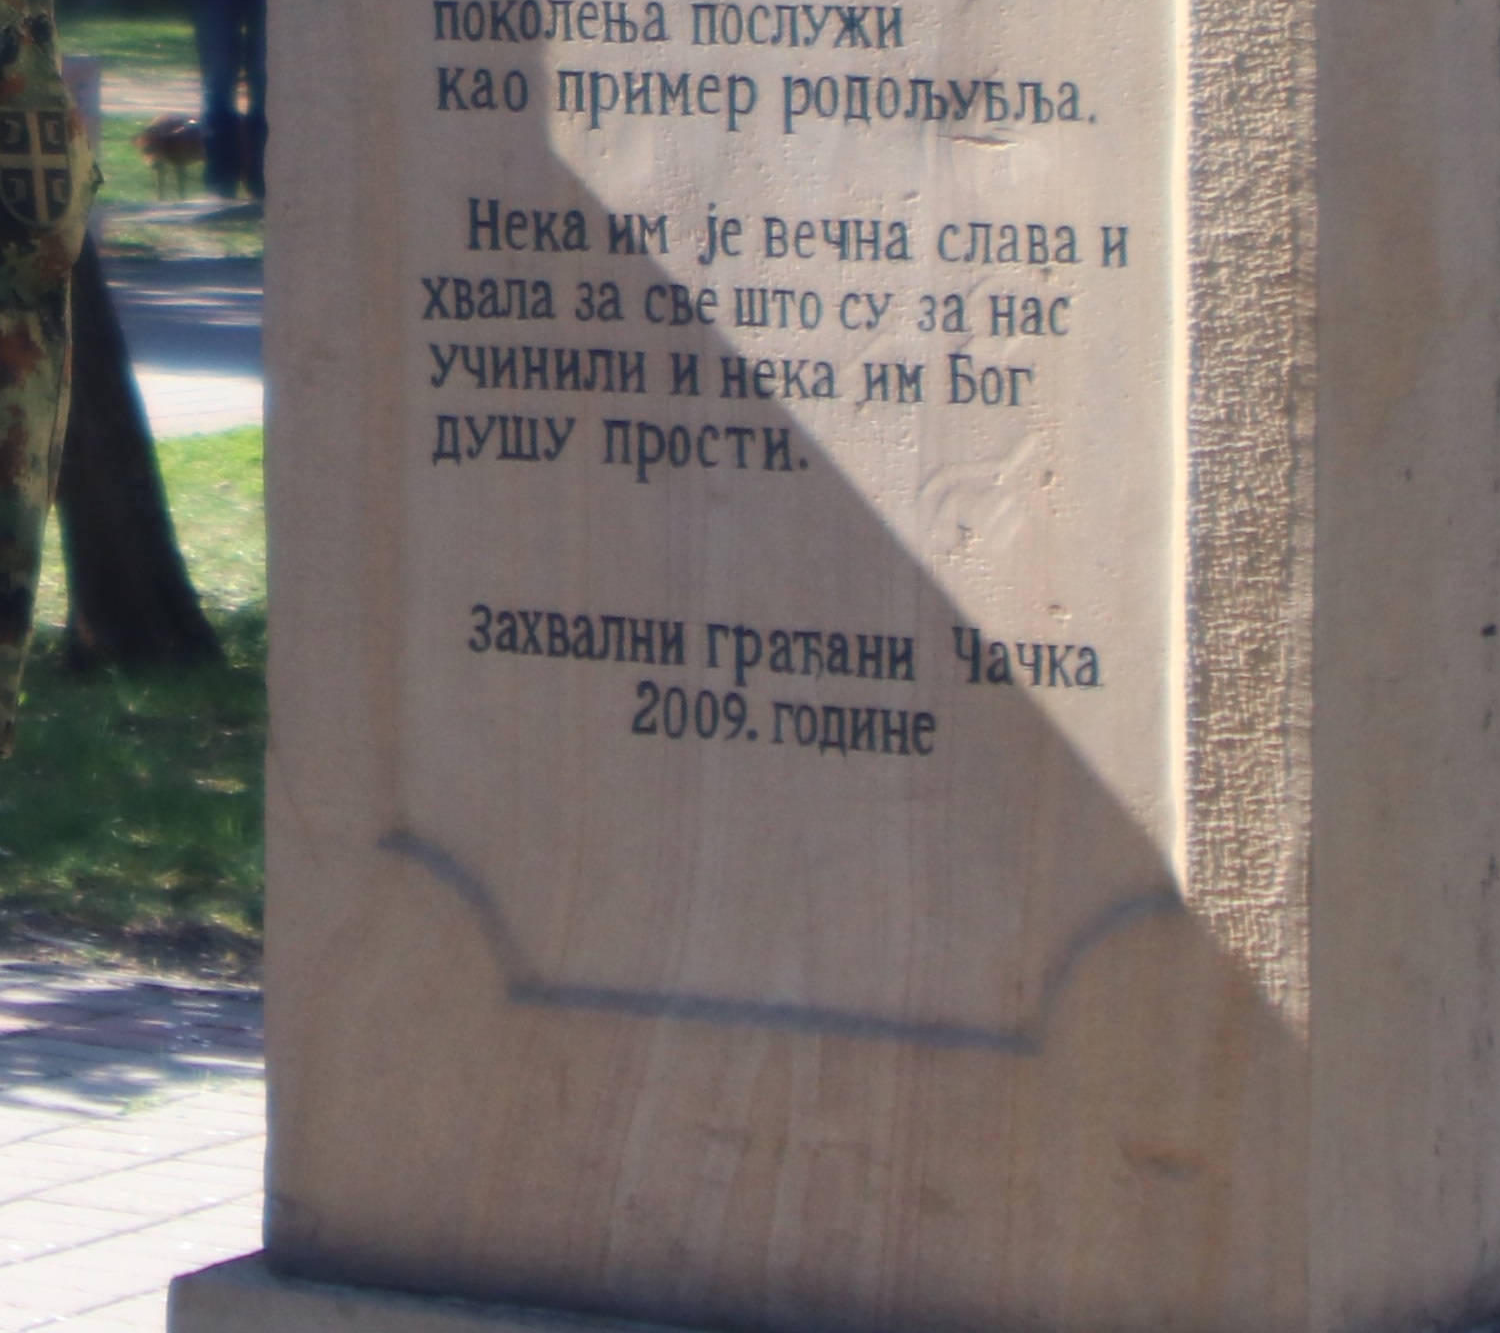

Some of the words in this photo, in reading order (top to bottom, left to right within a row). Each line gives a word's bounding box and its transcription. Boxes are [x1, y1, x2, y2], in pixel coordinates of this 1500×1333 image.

[692, 0, 904, 47] послужи
[436, 63, 531, 111] као
[560, 69, 759, 131] пример
[469, 195, 589, 250] Нека
[604, 209, 669, 259] им
[699, 200, 743, 266] је
[764, 214, 913, 261] вечна
[937, 219, 1079, 263] слава
[1101, 223, 1130, 268] и
[420, 273, 555, 320] хвала
[577, 279, 623, 320] за
[643, 281, 719, 325] све
[735, 286, 824, 329] што
[839, 290, 892, 329] су
[919, 291, 966, 332] за
[991, 293, 1071, 335] нас
[429, 341, 646, 392] учинили
[672, 350, 700, 395] и
[720, 353, 837, 399] нека
[865, 360, 924, 403] им
[950, 350, 1035, 406] Бог
[433, 411, 575, 467] душу
[604, 416, 812, 483] прости.
[707, 620, 915, 685] грађани
[952, 627, 1102, 688] Чачка
[631, 681, 758, 741] 2009.
[774, 701, 937, 758] године
